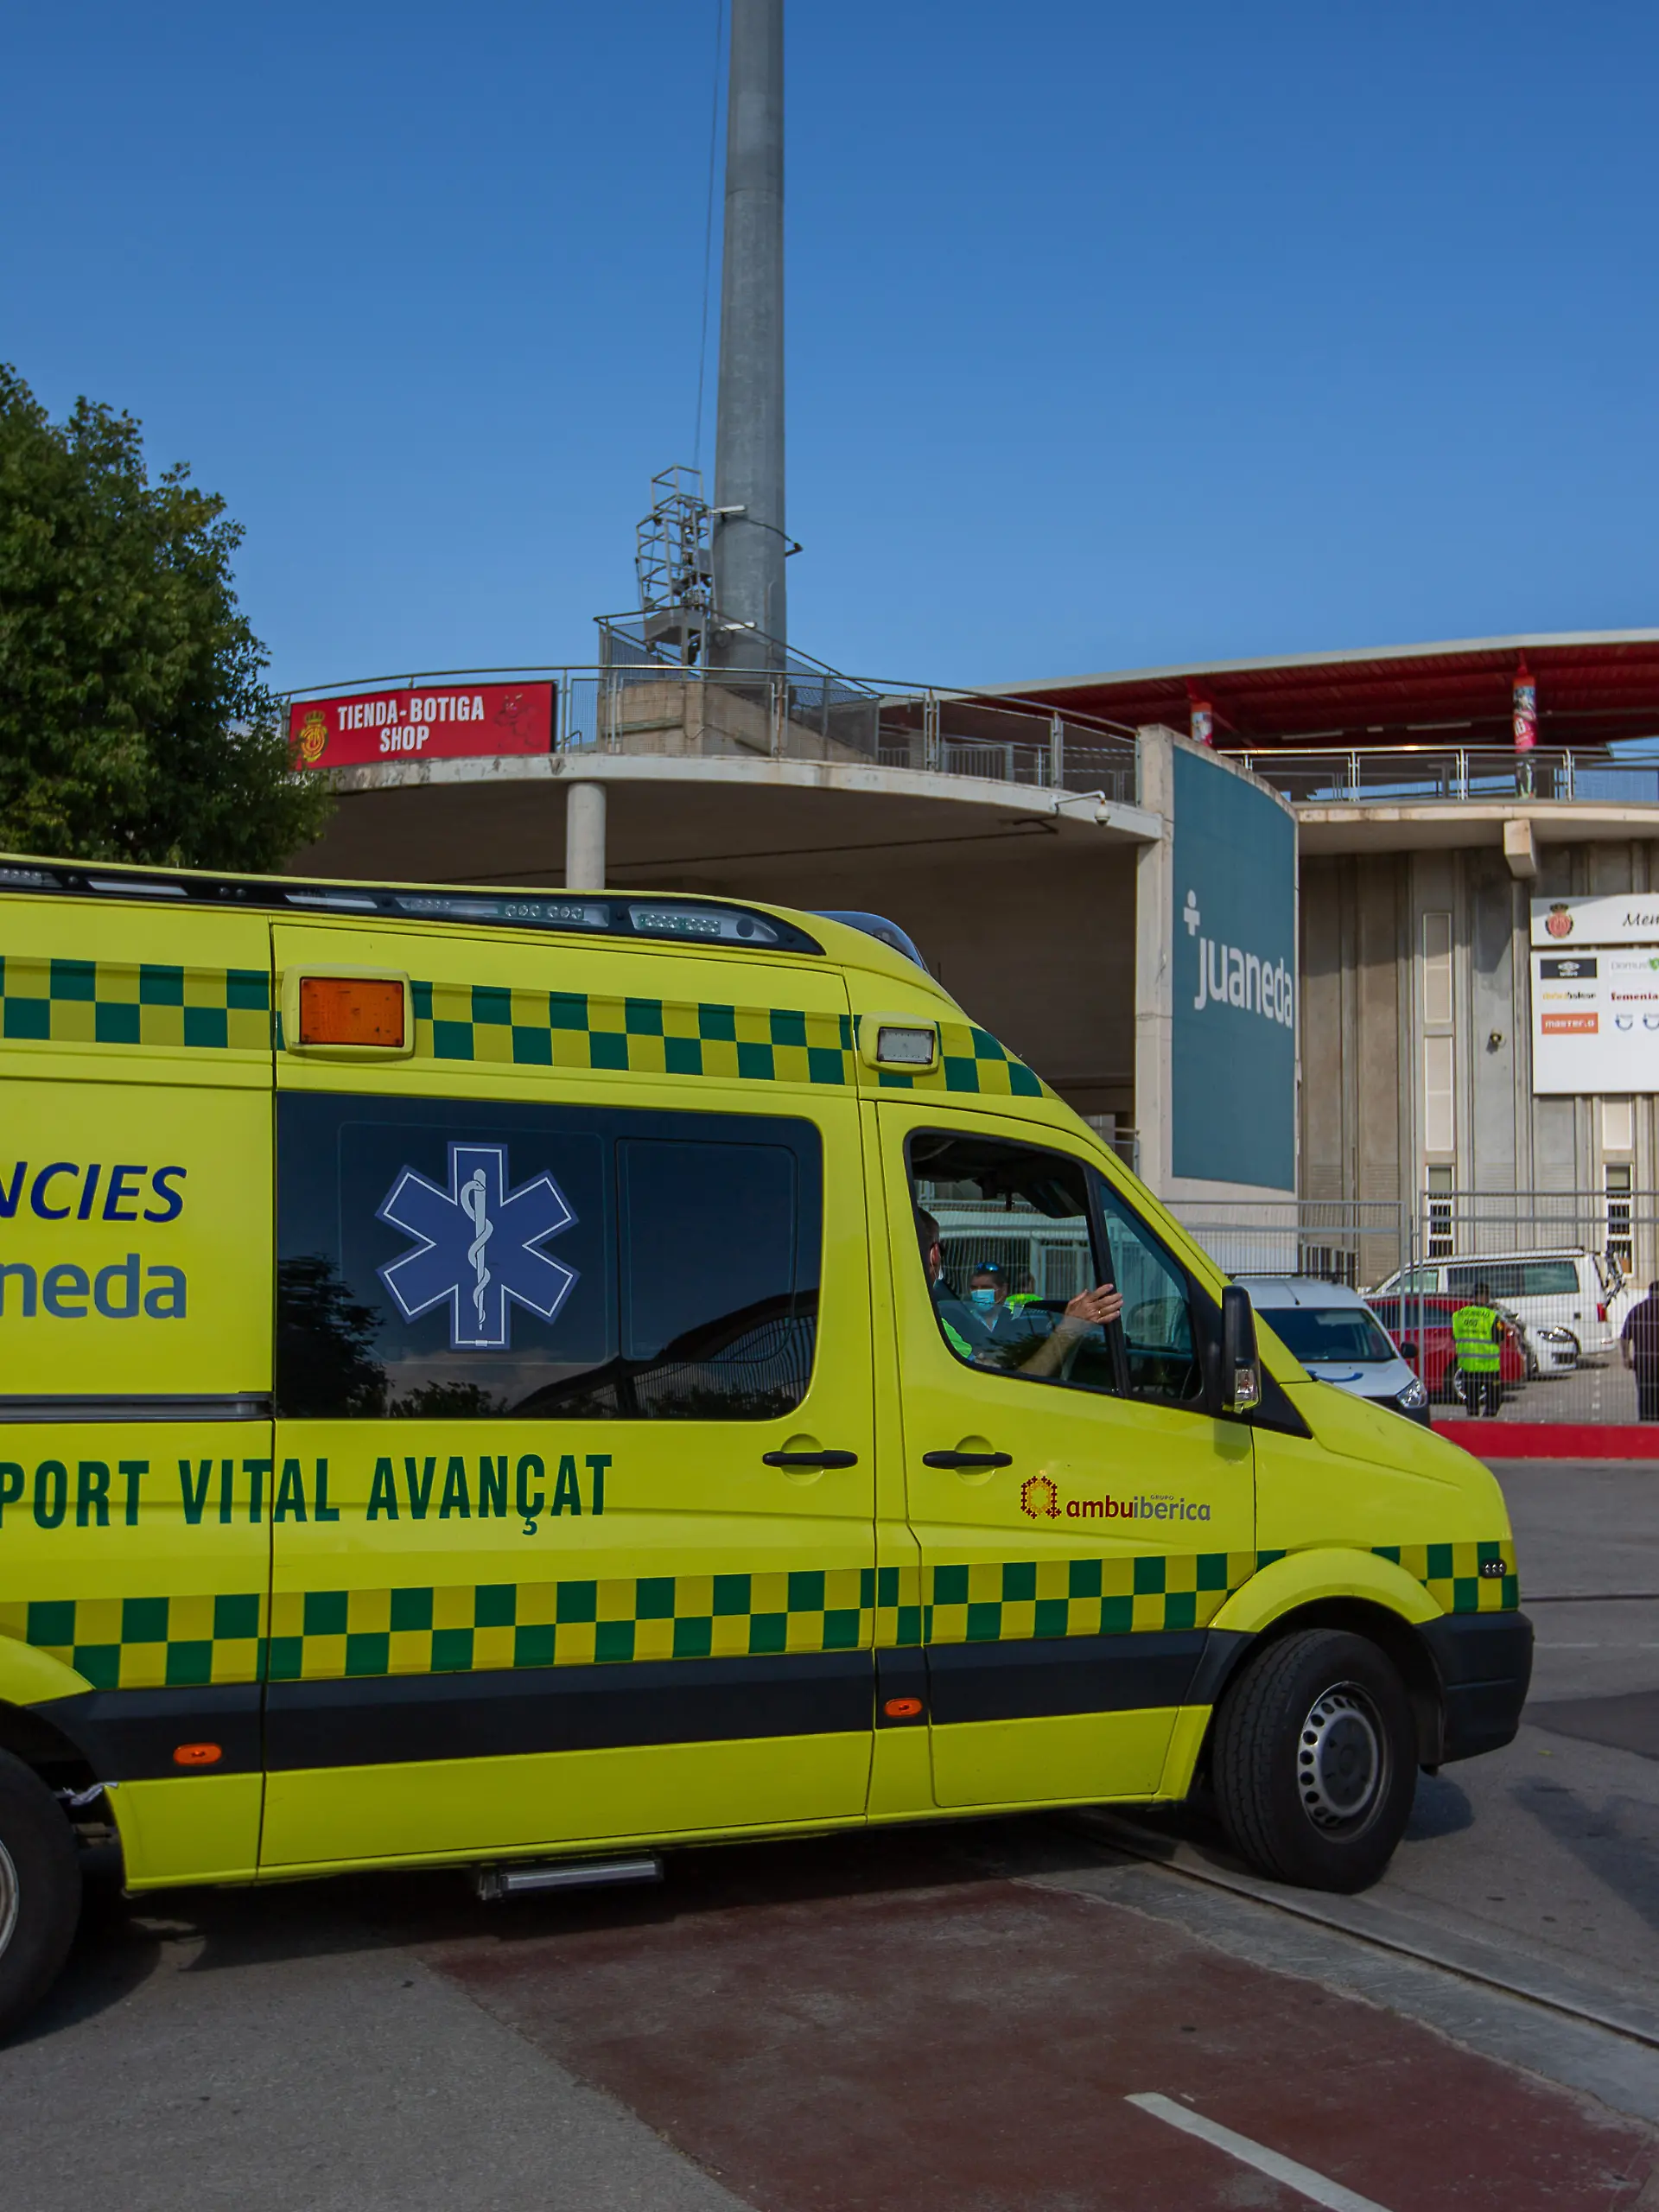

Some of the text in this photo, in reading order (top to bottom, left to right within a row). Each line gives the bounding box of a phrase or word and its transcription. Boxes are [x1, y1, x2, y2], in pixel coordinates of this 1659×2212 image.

[337, 696, 485, 731] TIENDA-BOTIGA
[379, 725, 430, 753] SHOP
[0, 1253, 187, 1319] neda
[0, 1453, 613, 1535] PORT VITAL AVANÇAT
[1066, 1495, 1211, 1521] ambuiberica
